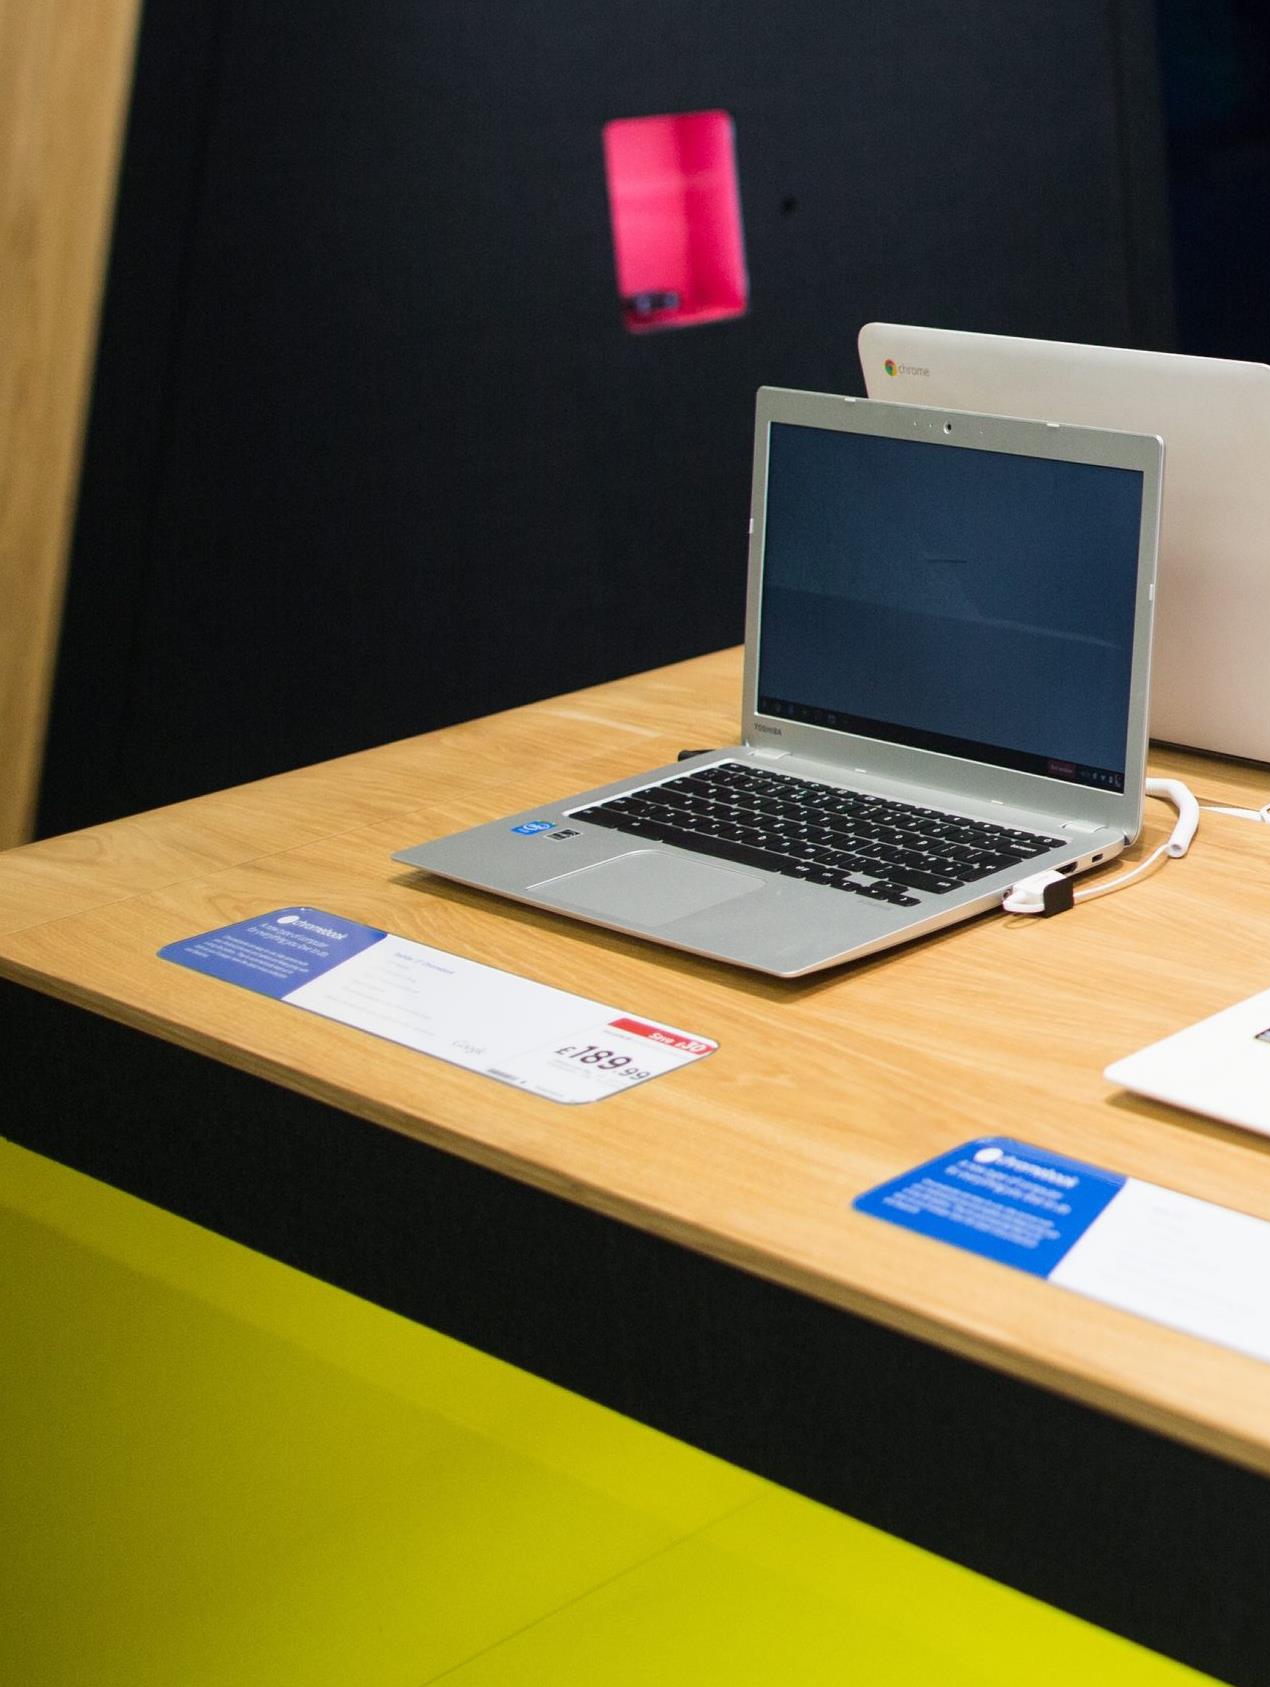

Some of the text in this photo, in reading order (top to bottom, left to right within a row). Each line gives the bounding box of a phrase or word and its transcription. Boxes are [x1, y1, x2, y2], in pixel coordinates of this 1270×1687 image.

[897, 360, 931, 377] chrome
[648, 1032, 675, 1045] Save
[674, 1040, 707, 1053] £30
[556, 1045, 651, 1080] £189.99
